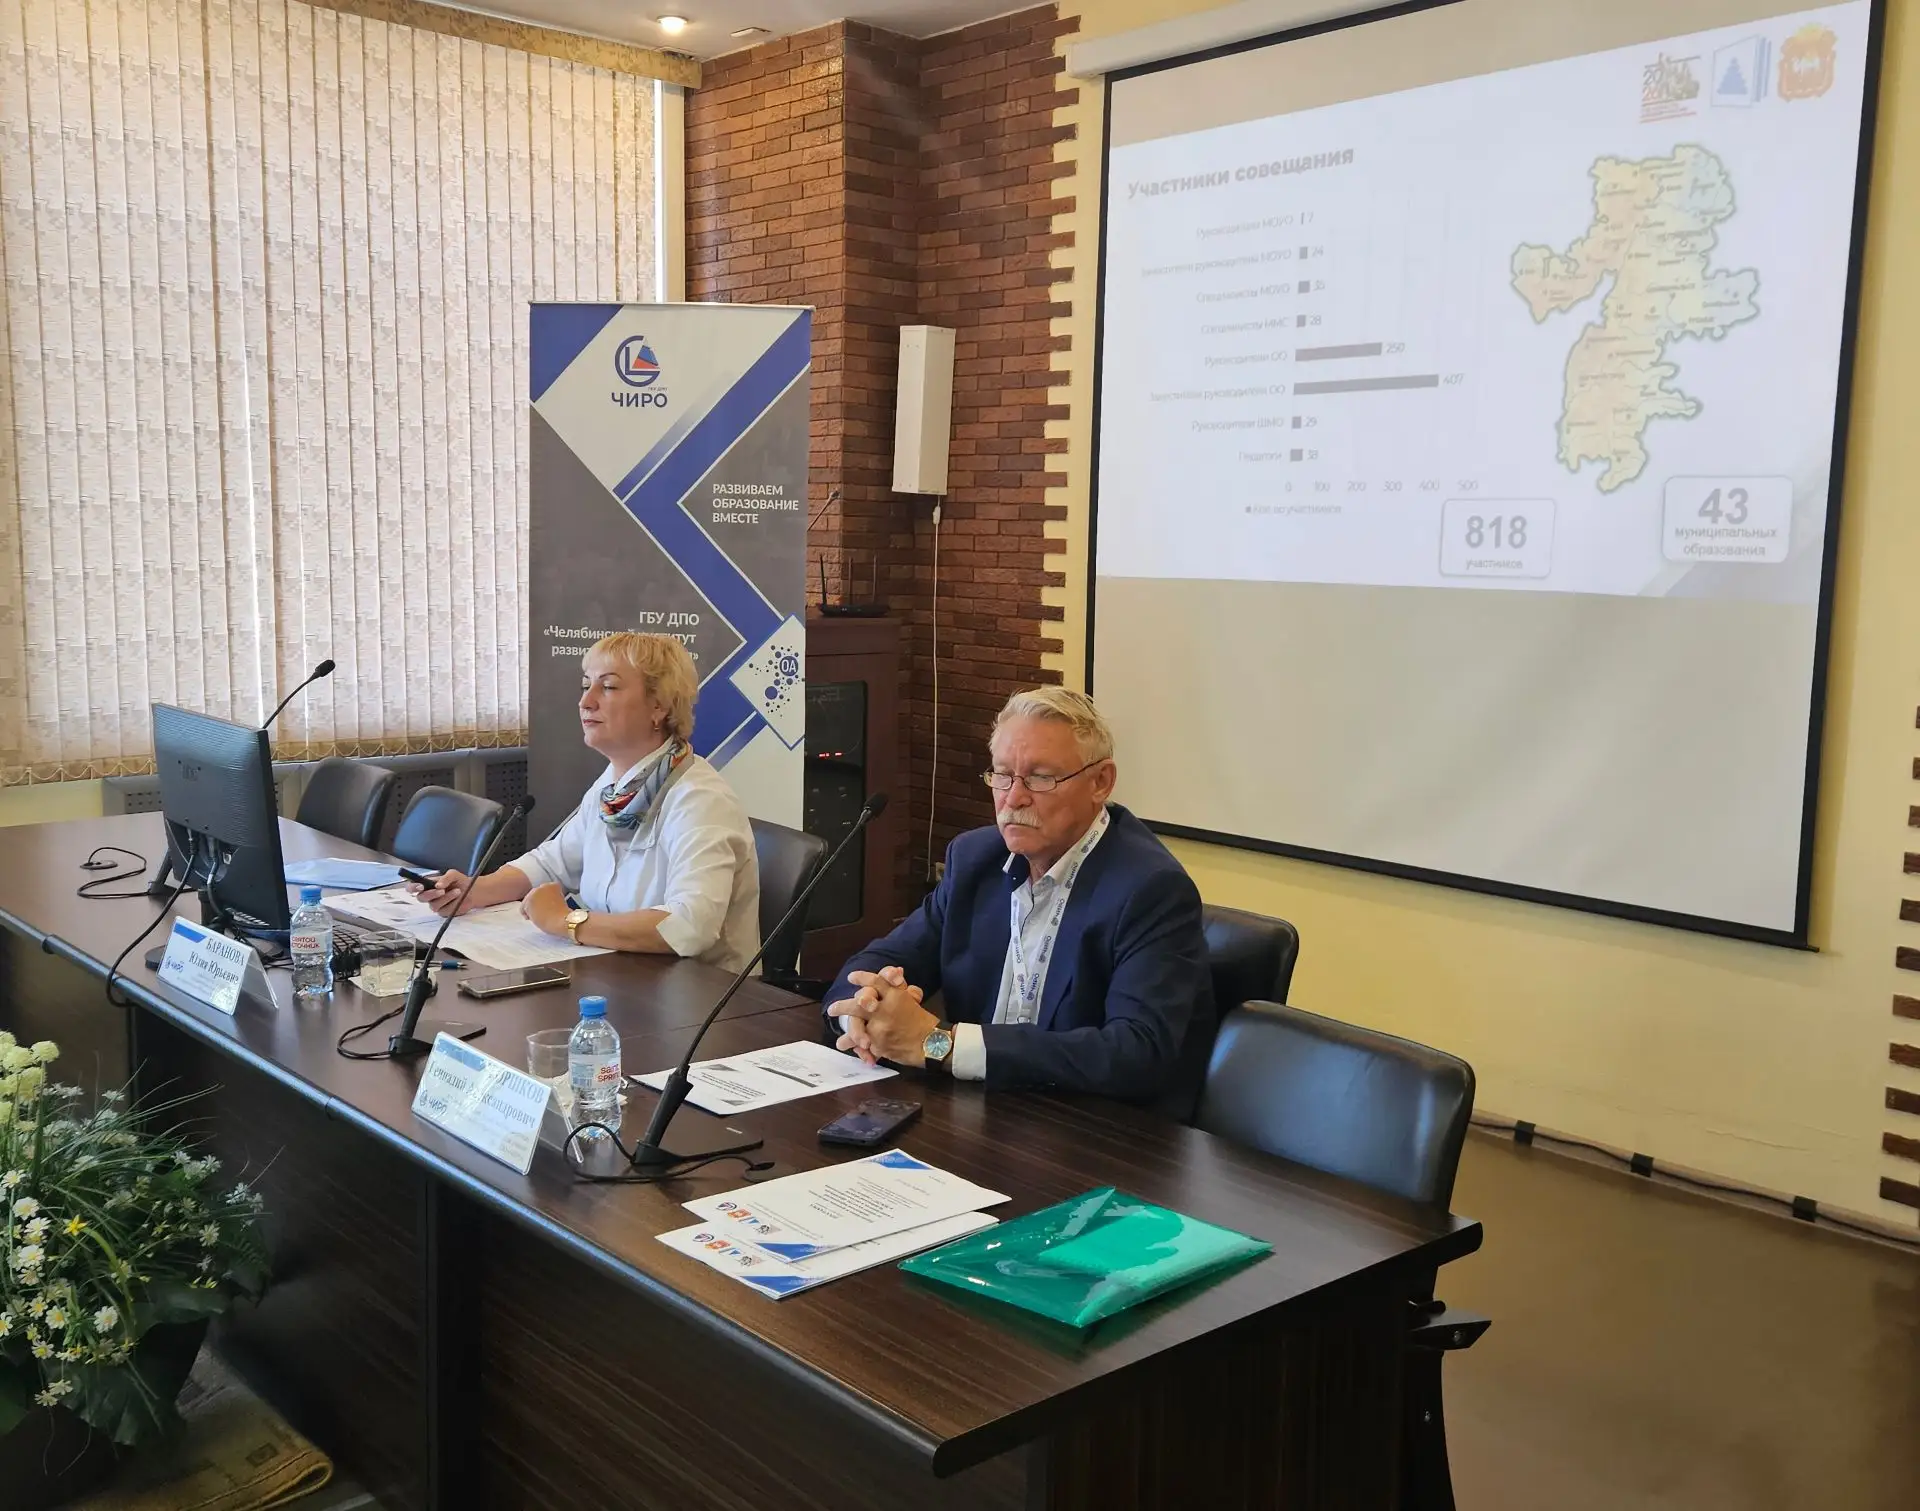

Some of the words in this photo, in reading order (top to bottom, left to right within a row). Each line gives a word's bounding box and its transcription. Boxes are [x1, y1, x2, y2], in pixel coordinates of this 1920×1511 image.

[1128, 170, 1230, 199] Участники
[1235, 148, 1355, 182] совещания
[1311, 246, 1324, 258] 24
[1310, 314, 1322, 326] 28
[1385, 343, 1405, 354] 250
[1443, 373, 1465, 387] 407
[611, 392, 668, 408] ЧИРО
[1305, 417, 1318, 428] 29
[712, 483, 784, 496] РАЗВИВАЕМ
[1285, 480, 1292, 493] 0
[1314, 480, 1331, 492] 100
[1347, 480, 1367, 492] 200
[1383, 480, 1403, 492] 300
[1419, 479, 1440, 492] 400
[1457, 479, 1479, 491] 500
[712, 498, 799, 511] ОБРАЗОВАНИЕ
[1698, 487, 1749, 525] 43
[712, 512, 759, 524] ВМЕСТЕ
[1465, 515, 1527, 549] 818
[1675, 527, 1777, 540] муниципальных
[1683, 543, 1766, 557] образования
[1466, 557, 1523, 571] участников
[639, 611, 665, 624] ГБУ
[667, 613, 700, 627] ДПО
[206, 937, 245, 966] БАРАНОВА
[188, 951, 209, 971] Юлия
[428, 1060, 467, 1091] Геннадий
